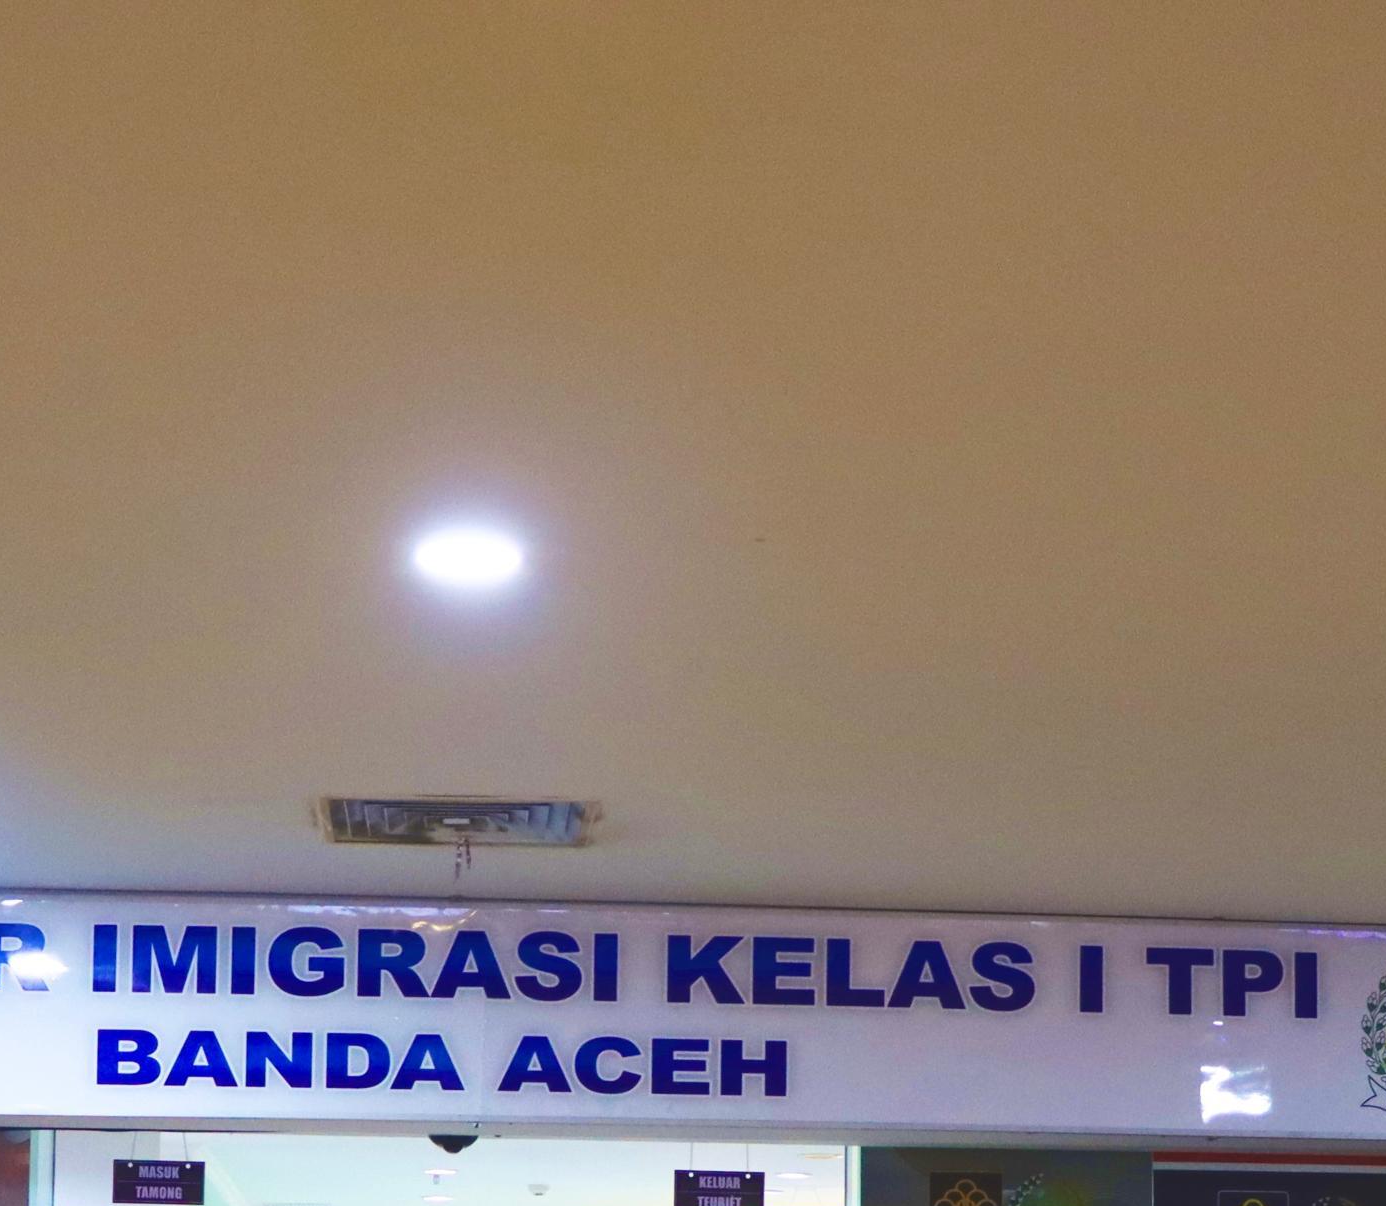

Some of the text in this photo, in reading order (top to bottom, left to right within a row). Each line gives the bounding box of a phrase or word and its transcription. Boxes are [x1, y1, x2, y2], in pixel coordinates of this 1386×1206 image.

[92, 923, 619, 1003] IMIGRASI
[666, 934, 1036, 1014] KELAS
[1079, 944, 1104, 1014] I
[1146, 946, 1319, 1019] TPI
[96, 1027, 788, 1098] BANDA ACEH
[138, 1165, 180, 1179] MASUK
[699, 1176, 741, 1189] KELUAR
[135, 1186, 183, 1200] TAMONG
